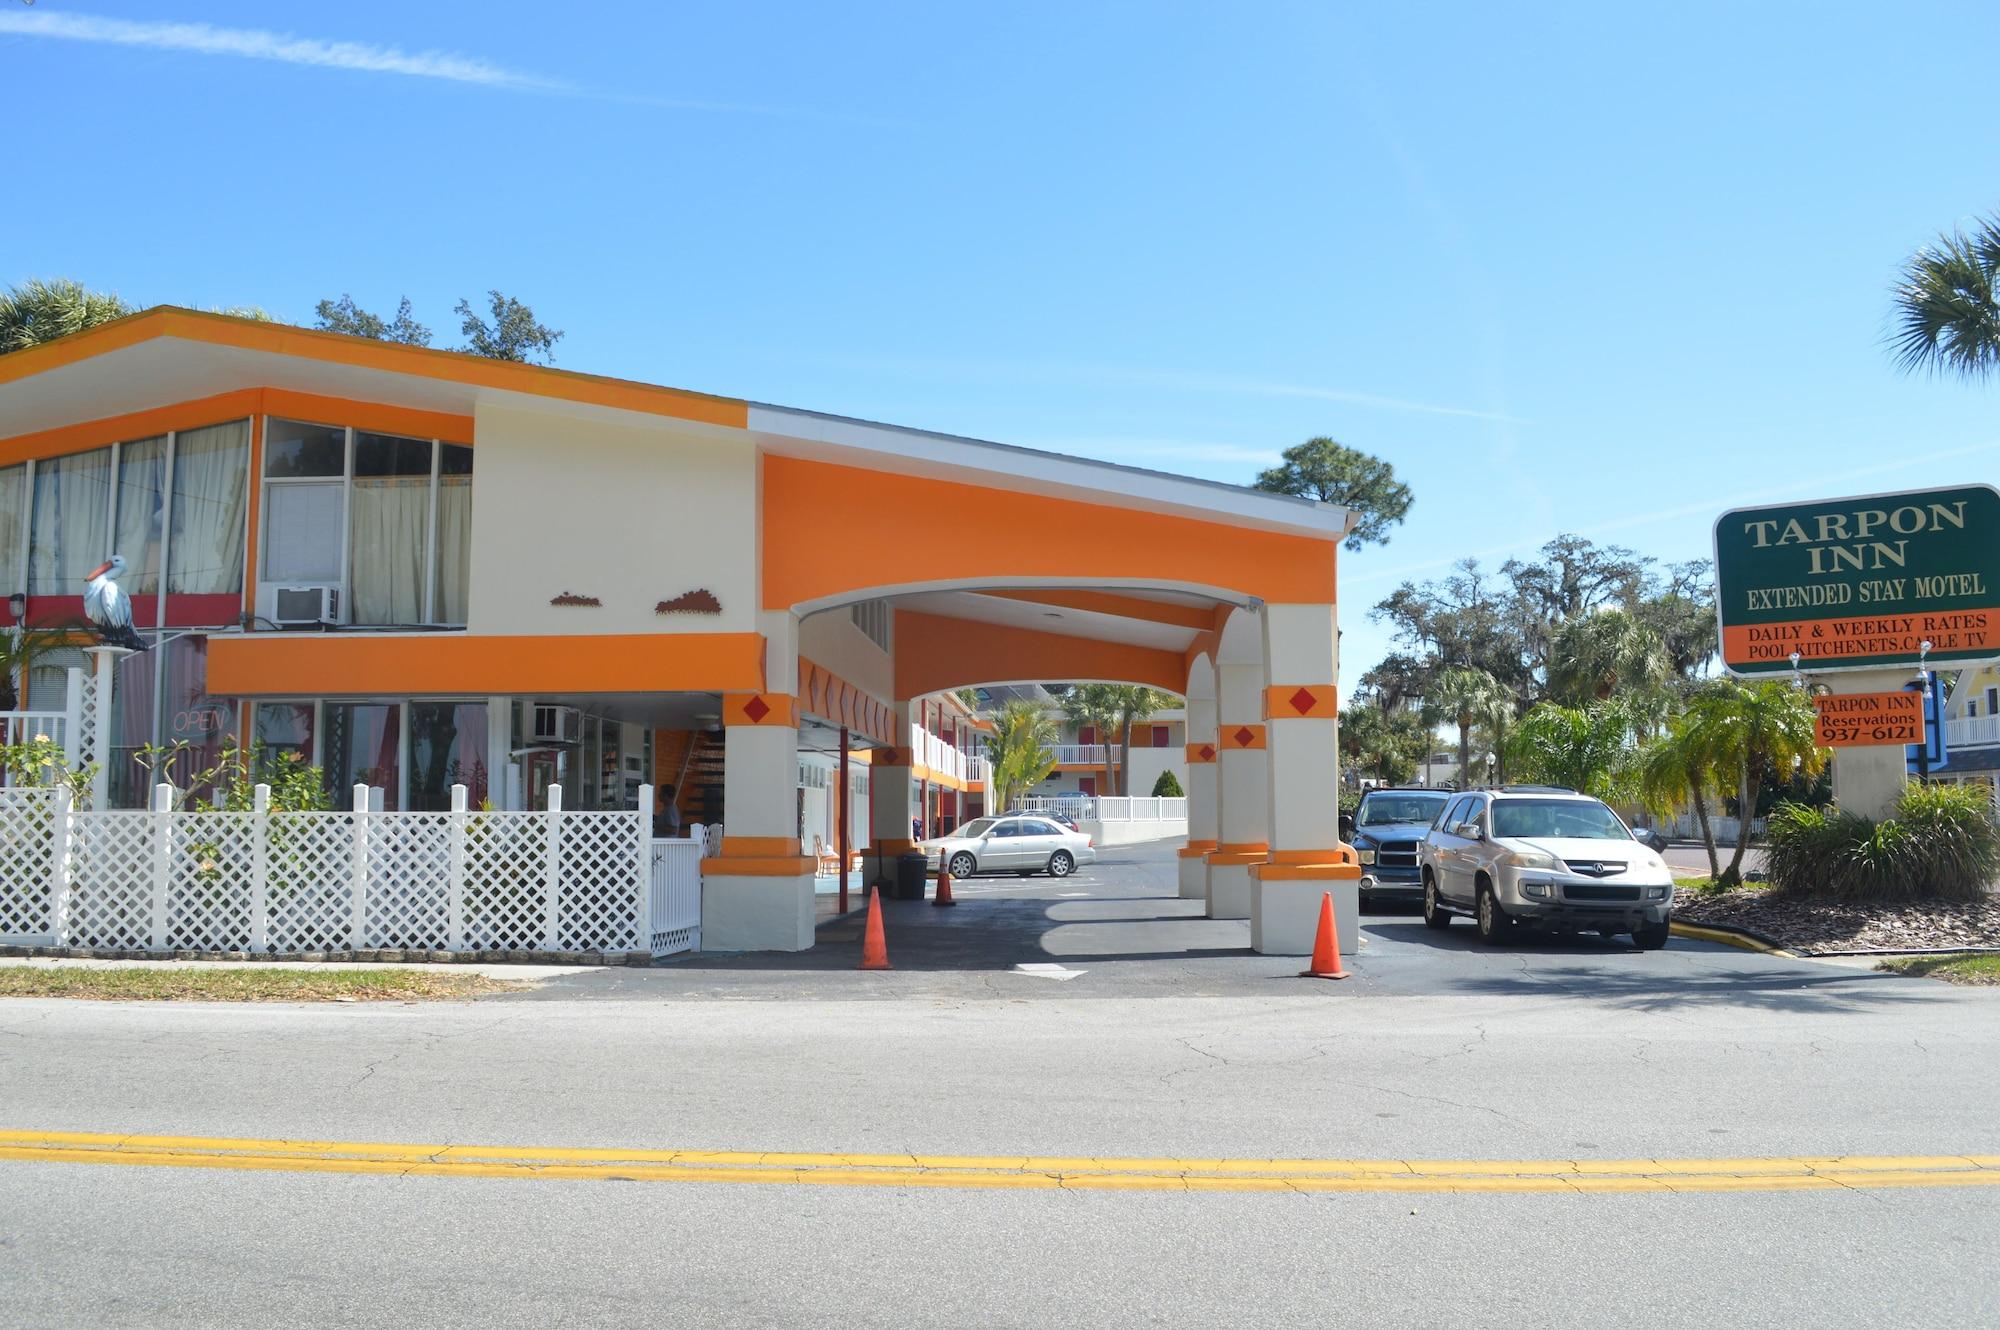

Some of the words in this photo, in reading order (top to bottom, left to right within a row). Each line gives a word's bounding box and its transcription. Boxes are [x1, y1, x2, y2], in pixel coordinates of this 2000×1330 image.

[1745, 501, 1968, 548] TARPON
[1806, 540, 1909, 575] INN
[1747, 583, 1851, 610] EXTENDED
[1859, 578, 1906, 603] STAY
[1914, 573, 1986, 599] MOTEL
[1749, 625, 1802, 641] DAILY
[1811, 624, 1825, 638] &
[1832, 617, 1914, 637] WEEKLY
[1923, 613, 1987, 632] RATES
[1964, 631, 1987, 647] TV
[1818, 697, 1880, 713] TARPON
[1887, 696, 1915, 710] INN
[174, 710, 226, 732] OPEN
[1822, 713, 1916, 727] Reservations
[1822, 726, 1915, 742] 937-6121
